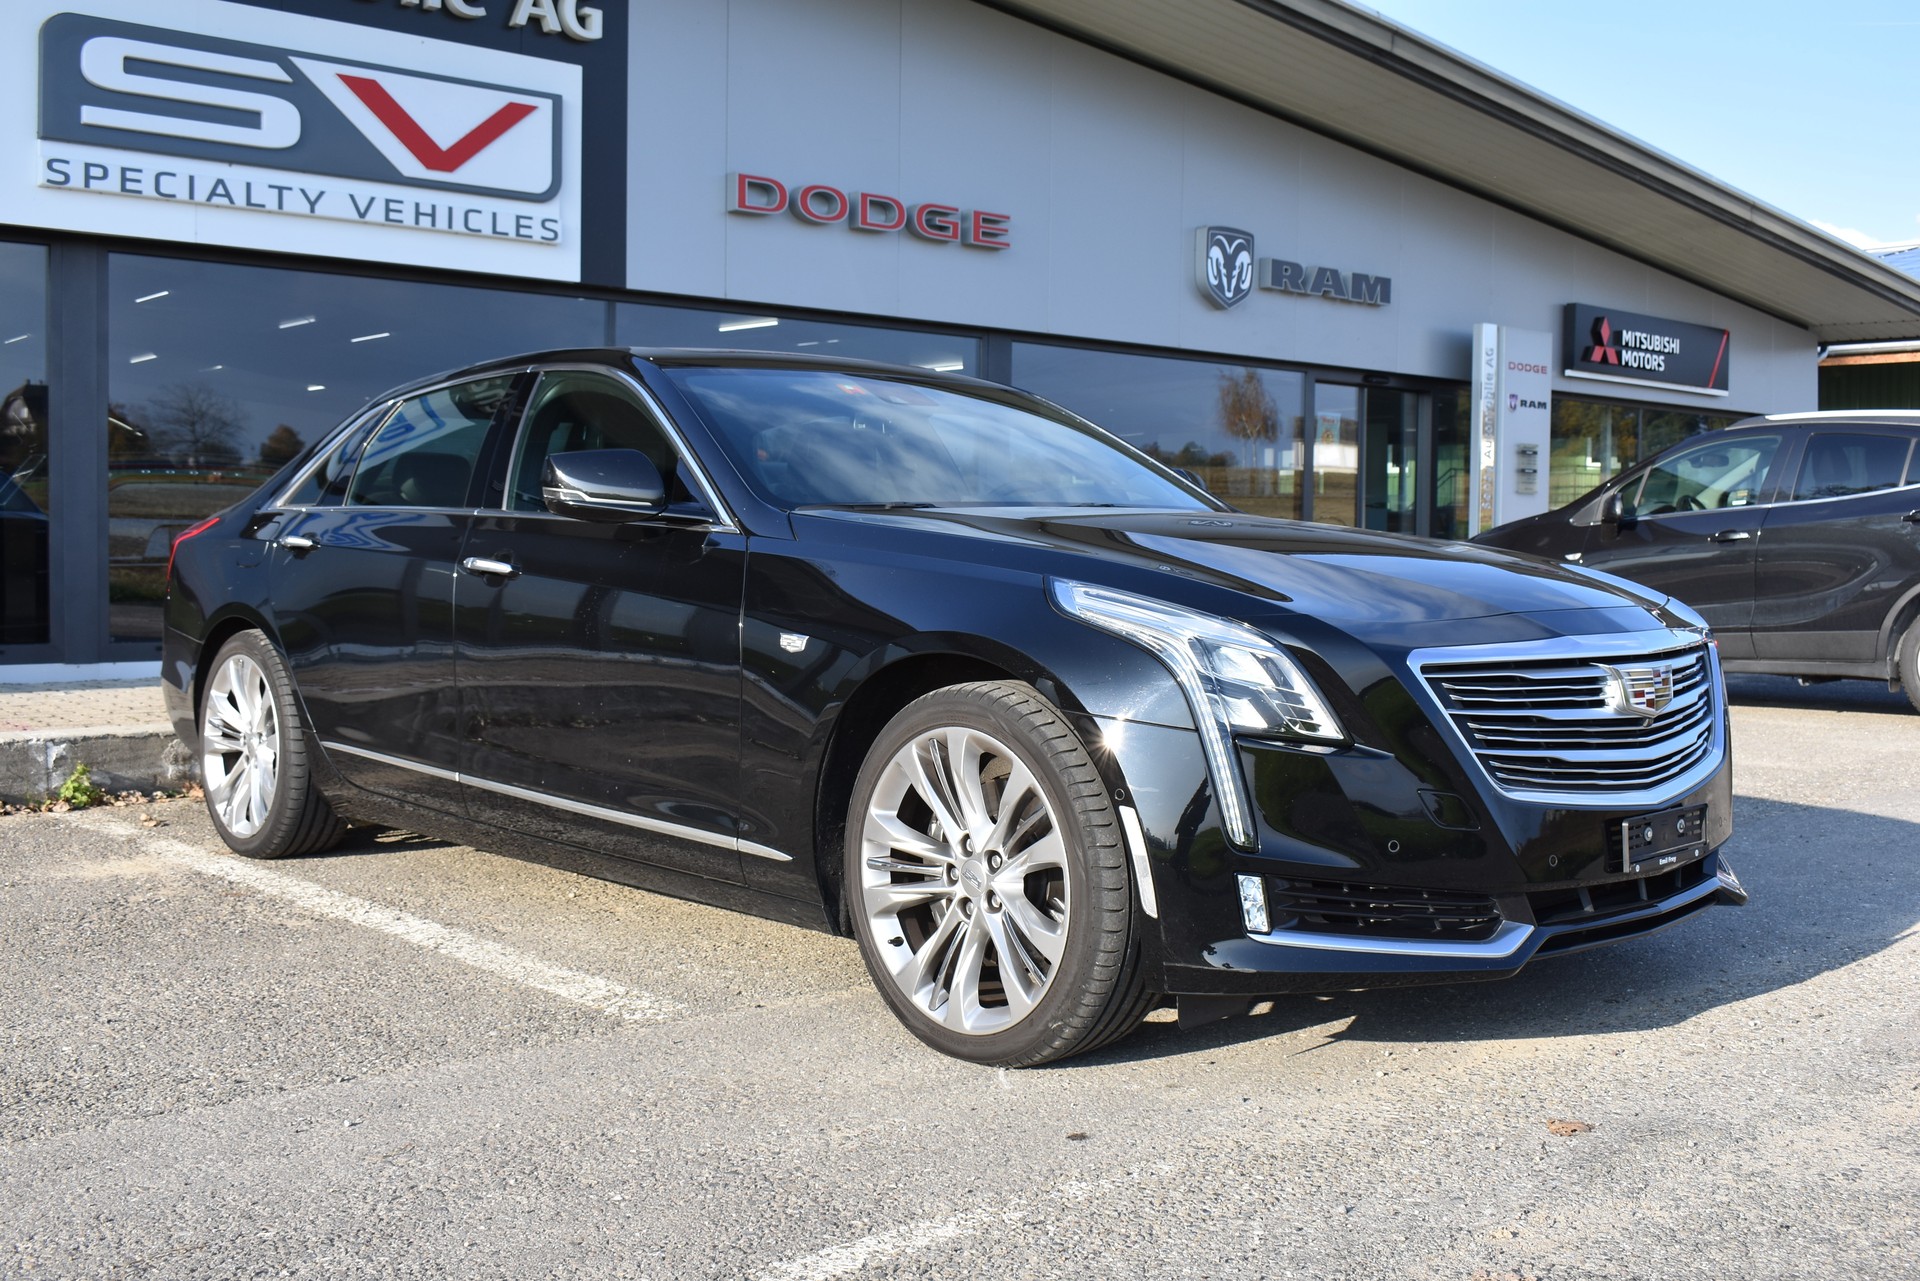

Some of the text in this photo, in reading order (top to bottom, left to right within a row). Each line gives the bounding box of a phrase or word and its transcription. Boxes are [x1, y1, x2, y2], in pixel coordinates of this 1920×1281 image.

[508, 0, 603, 41] AG
[45, 157, 559, 242] SPECIALTY VEHICLES
[734, 172, 1011, 249] DODGE
[1268, 257, 1392, 306] RAM
[1621, 329, 1680, 354] MITSUBISHI
[1485, 347, 1495, 368] AG
[1508, 361, 1548, 374] DODGE
[1621, 350, 1665, 372] MOTORS
[1519, 399, 1548, 410] RAM
